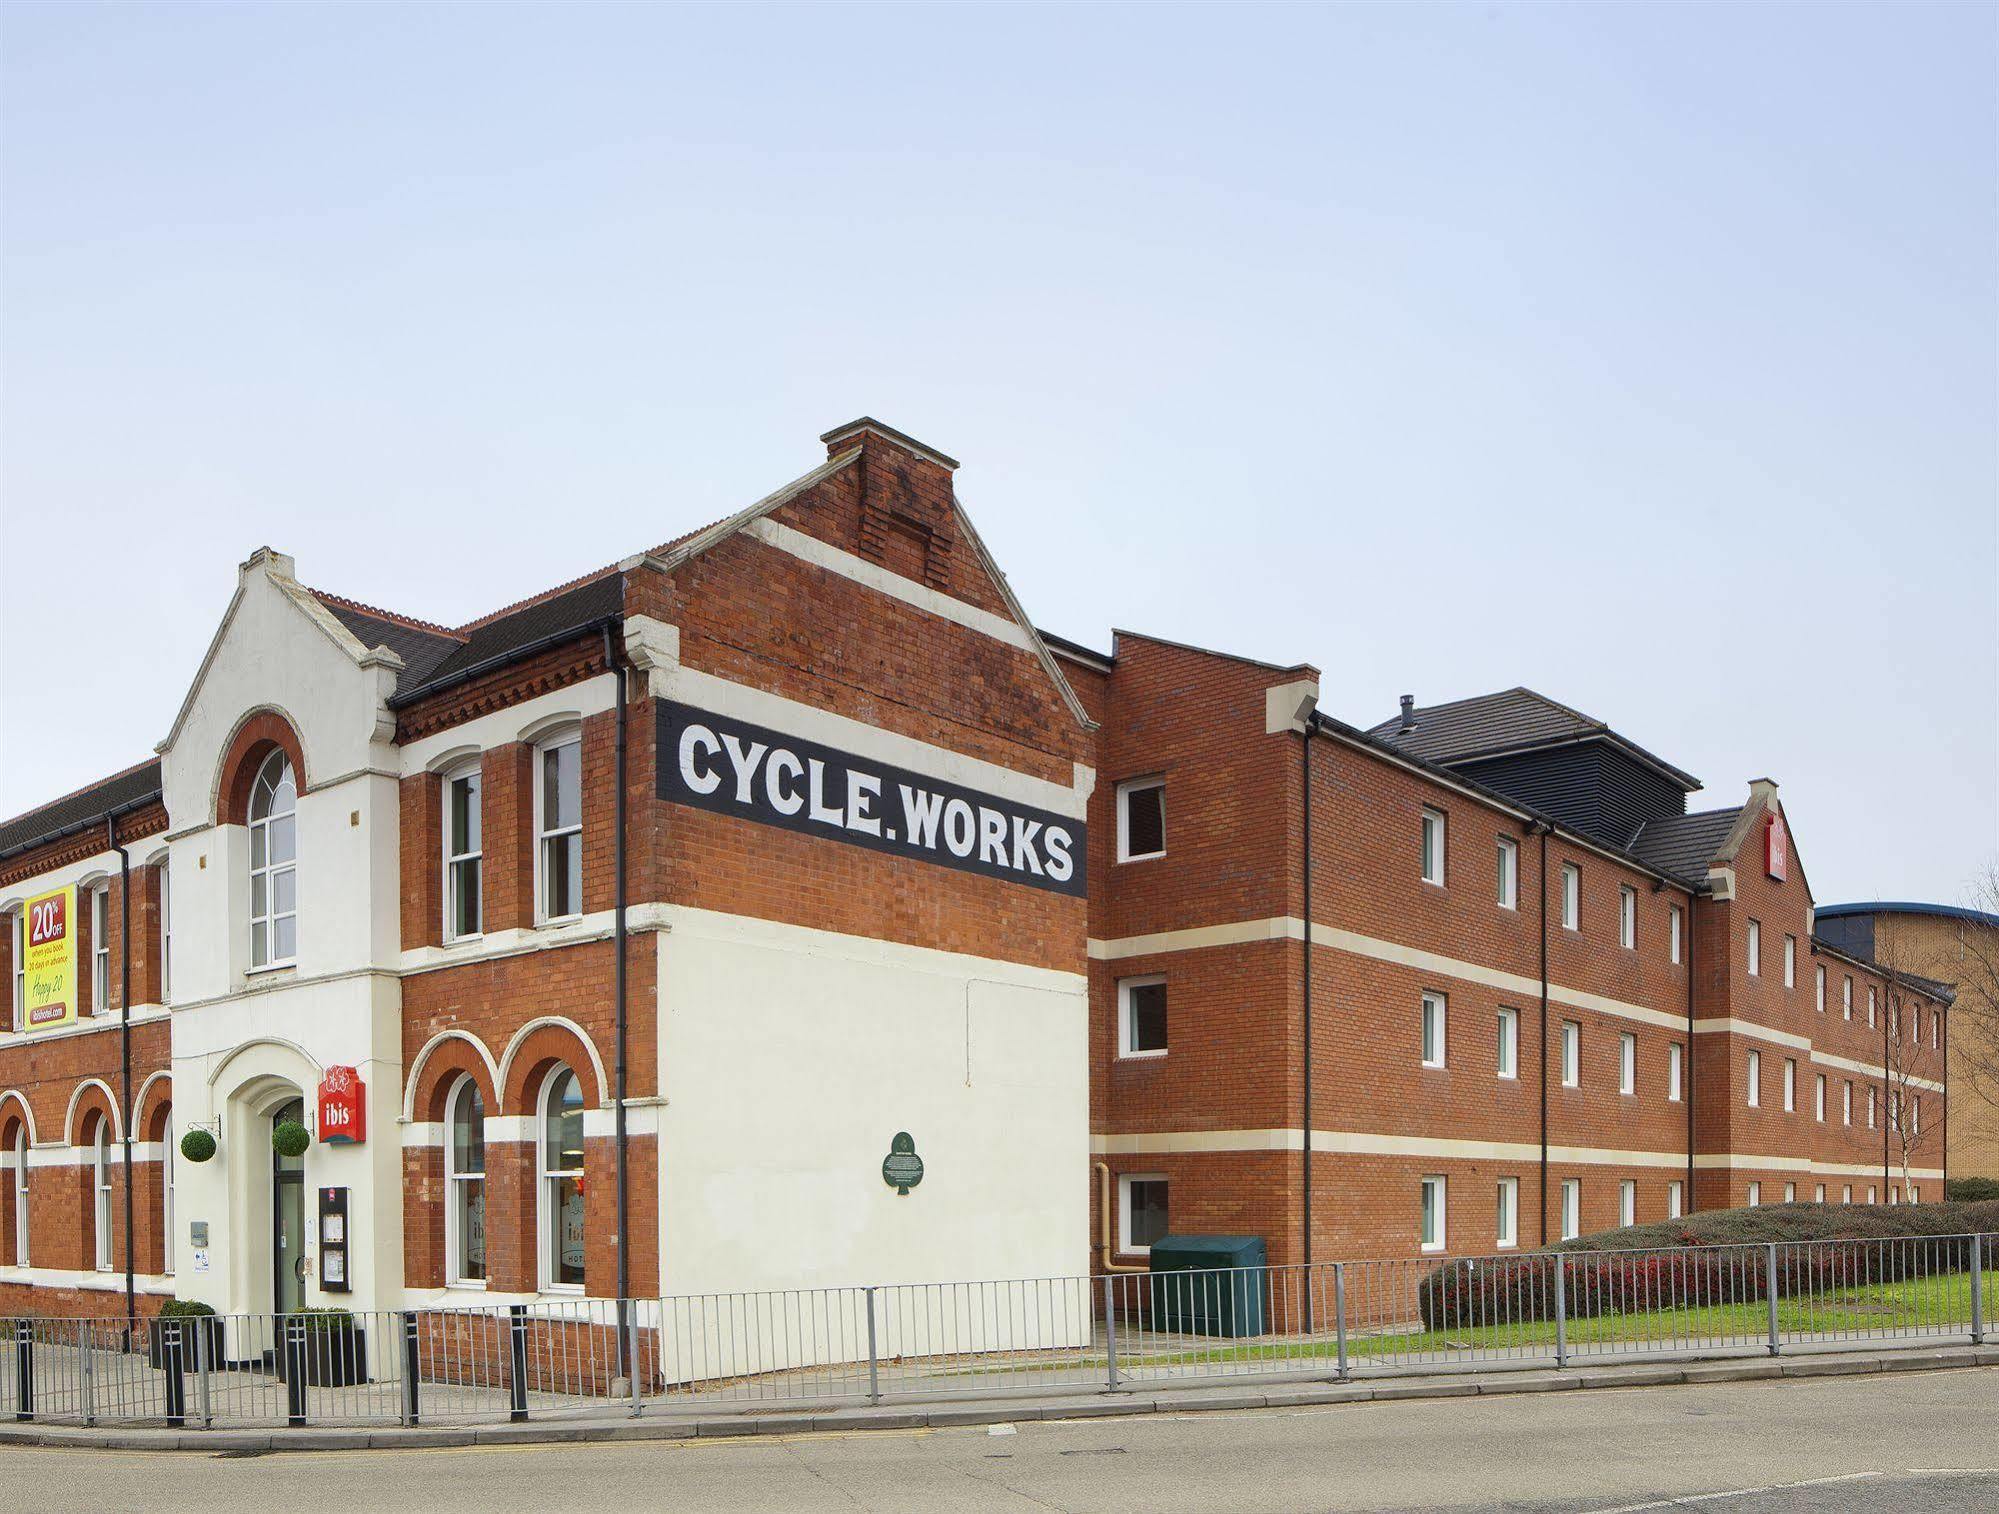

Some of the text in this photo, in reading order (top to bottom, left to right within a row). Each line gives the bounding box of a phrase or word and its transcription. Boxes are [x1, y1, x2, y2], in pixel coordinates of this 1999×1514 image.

[53, 923, 63, 936] OFF
[32, 943, 65, 958] when you book
[29, 961, 35, 971] 20
[35, 960, 45, 971] days
[50, 955, 68, 966] advance
[32, 974, 63, 1005] Happy 20
[33, 1008, 63, 1021] ibishotel.com
[325, 1102, 350, 1126] ibis
